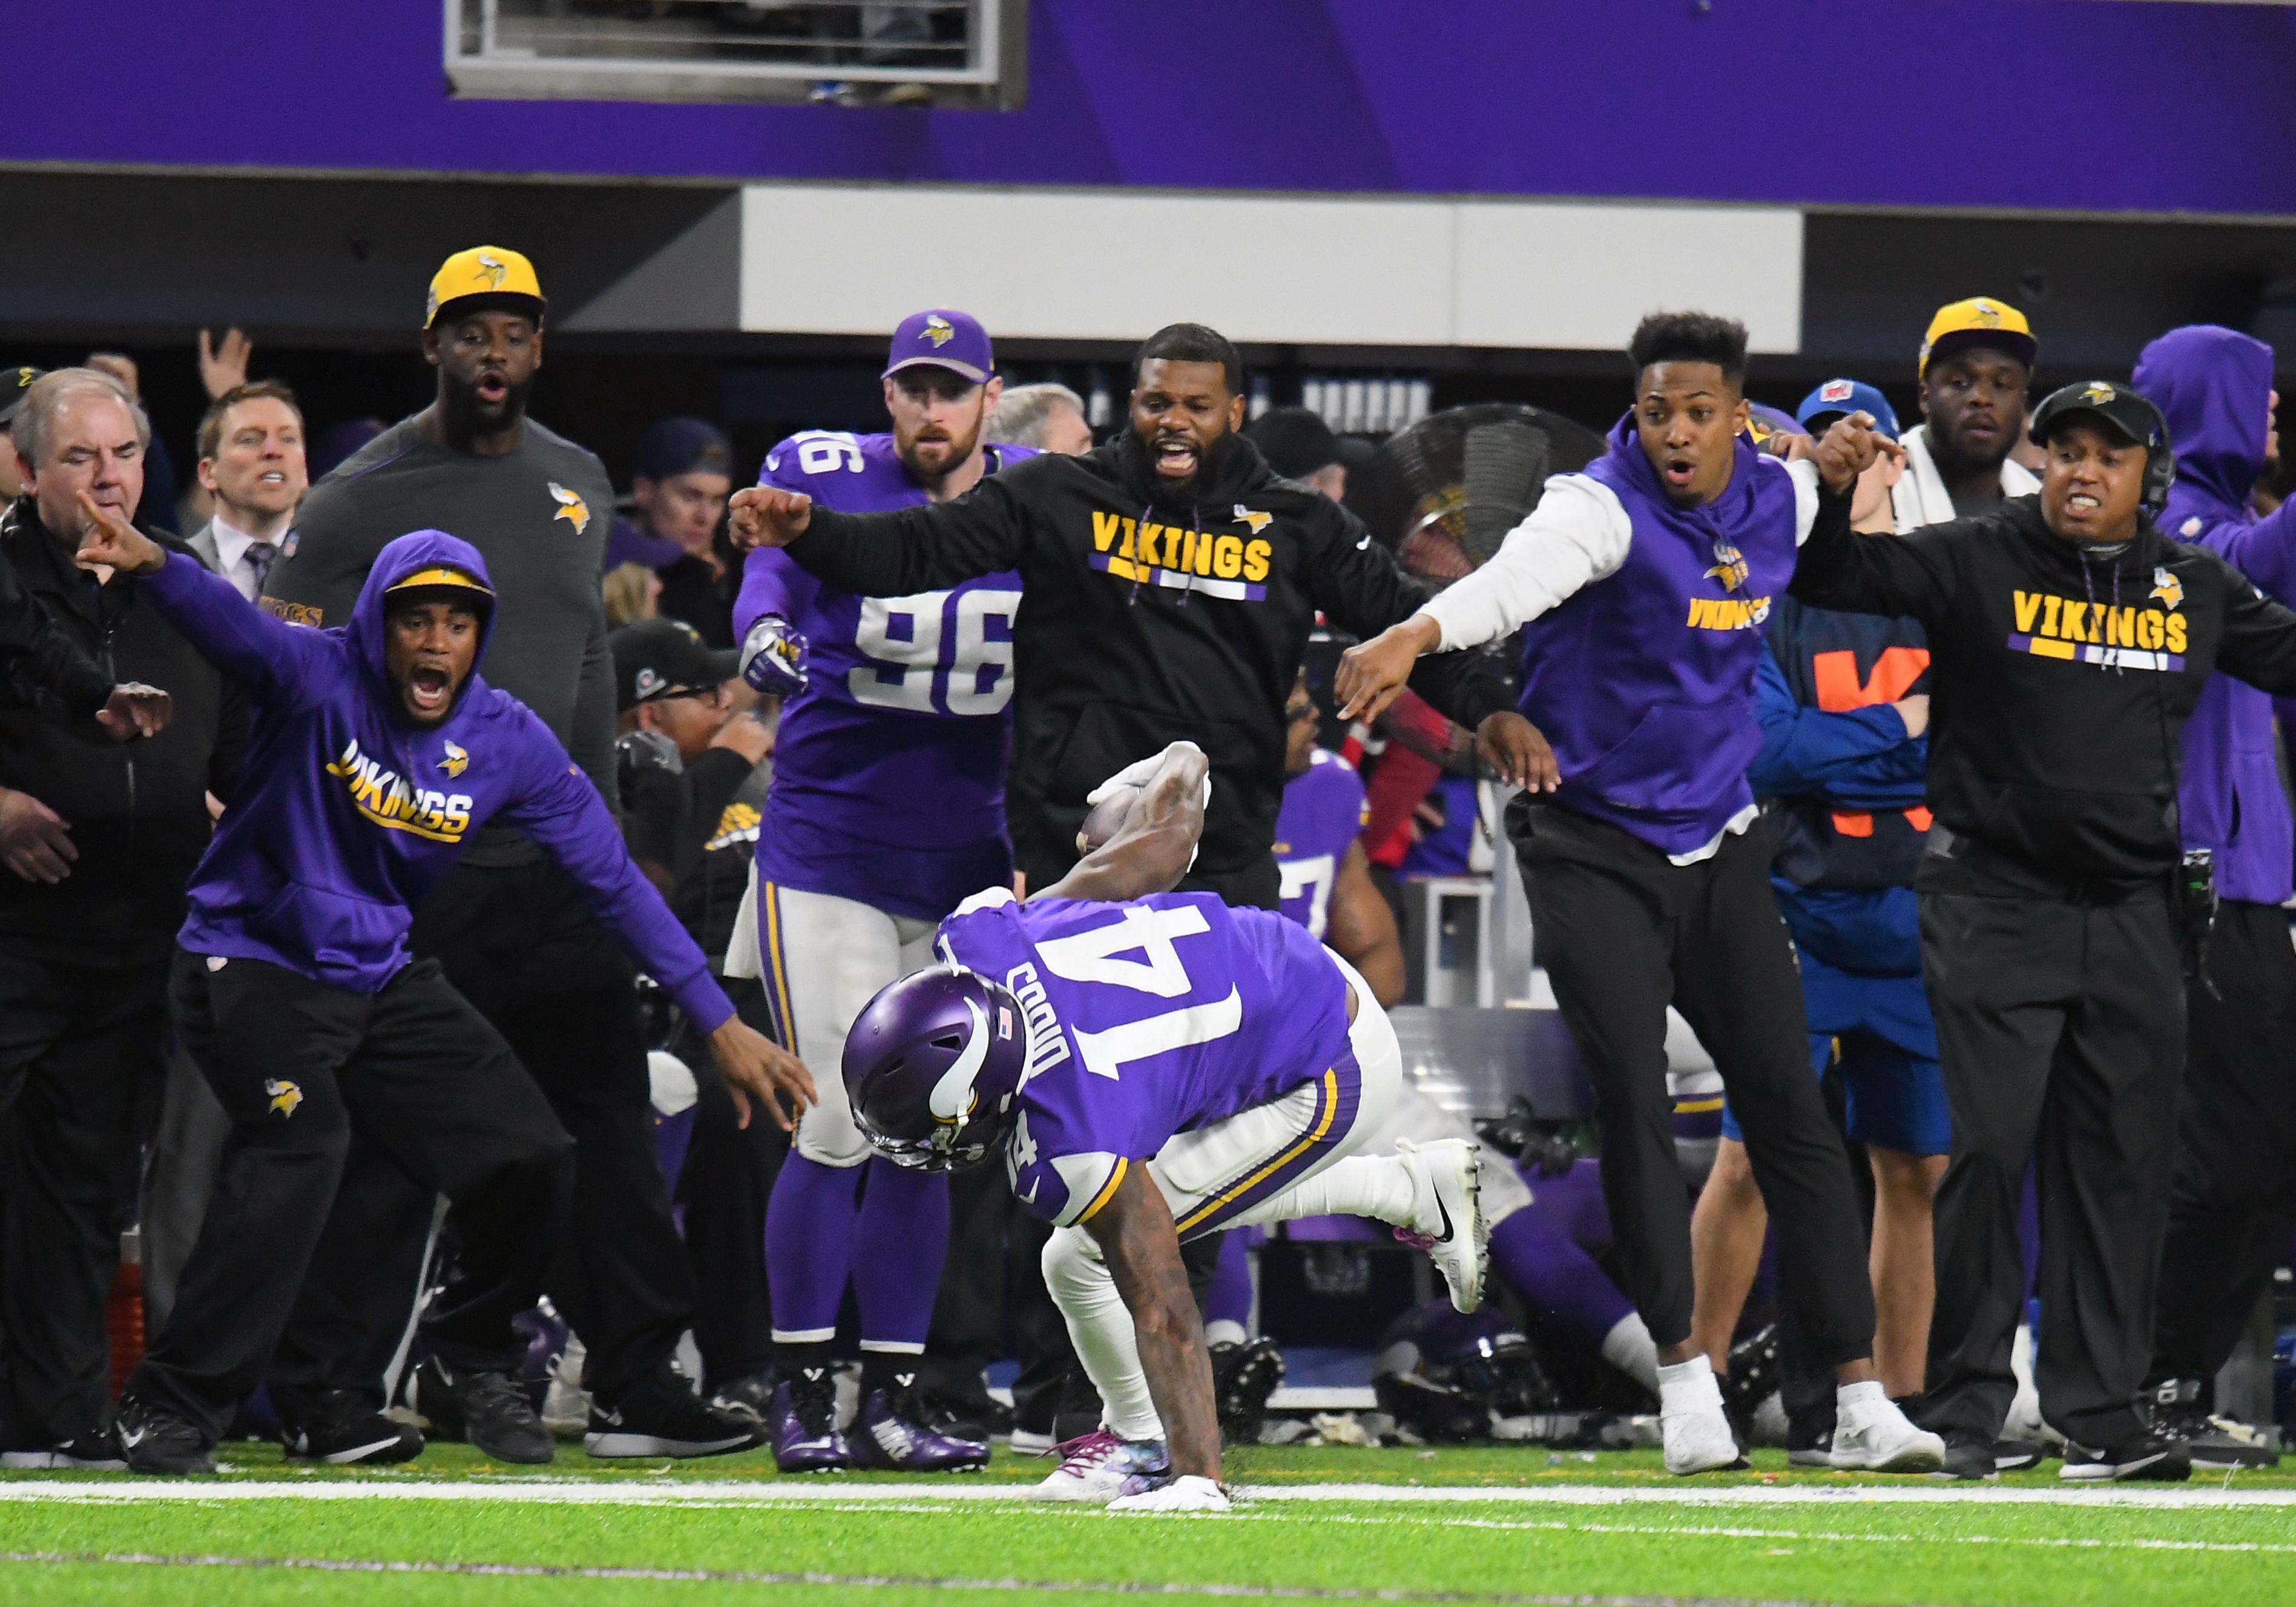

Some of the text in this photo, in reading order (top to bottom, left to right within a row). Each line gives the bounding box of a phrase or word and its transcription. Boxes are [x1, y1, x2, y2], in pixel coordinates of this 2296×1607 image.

[1092, 511, 1272, 581] VIKINGS
[847, 590, 1023, 715] 96
[2013, 590, 2187, 654] VIKINGS
[1035, 904, 1242, 1081] 14
